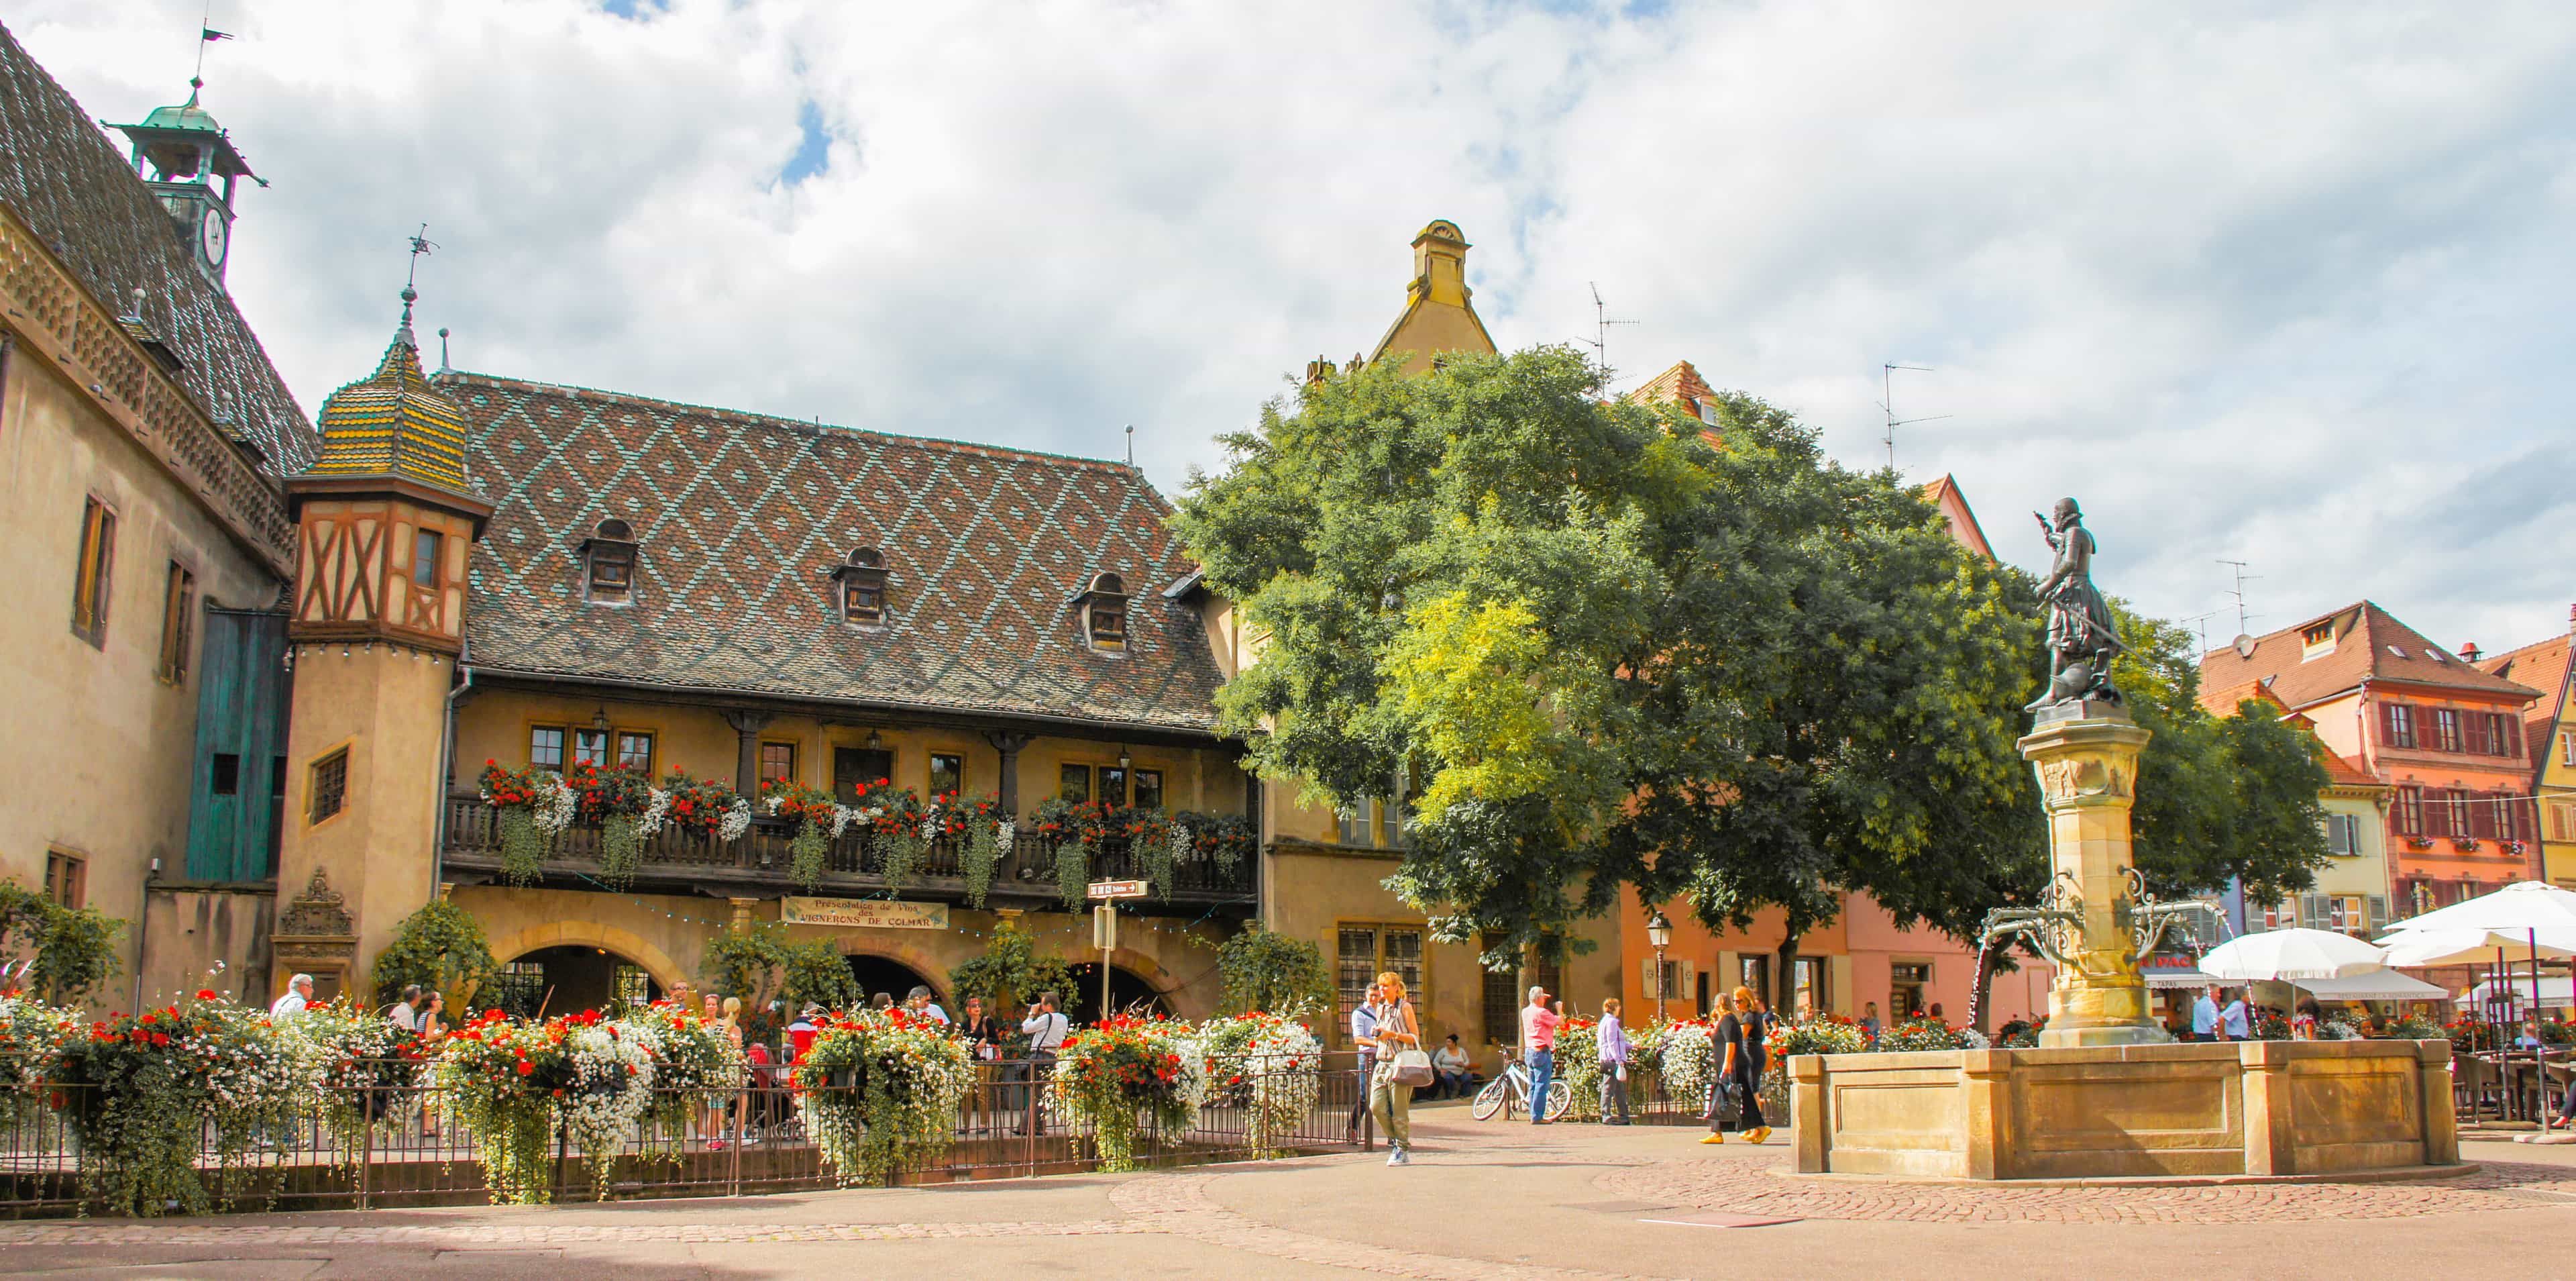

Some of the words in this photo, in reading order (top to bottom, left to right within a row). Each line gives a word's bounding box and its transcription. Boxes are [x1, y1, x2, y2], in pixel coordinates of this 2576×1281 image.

[879, 903, 892, 911] de
[898, 903, 918, 912] Vins
[801, 913, 860, 924] VIGNERONS
[868, 915, 881, 925] DE
[888, 917, 930, 927] COLMAR
